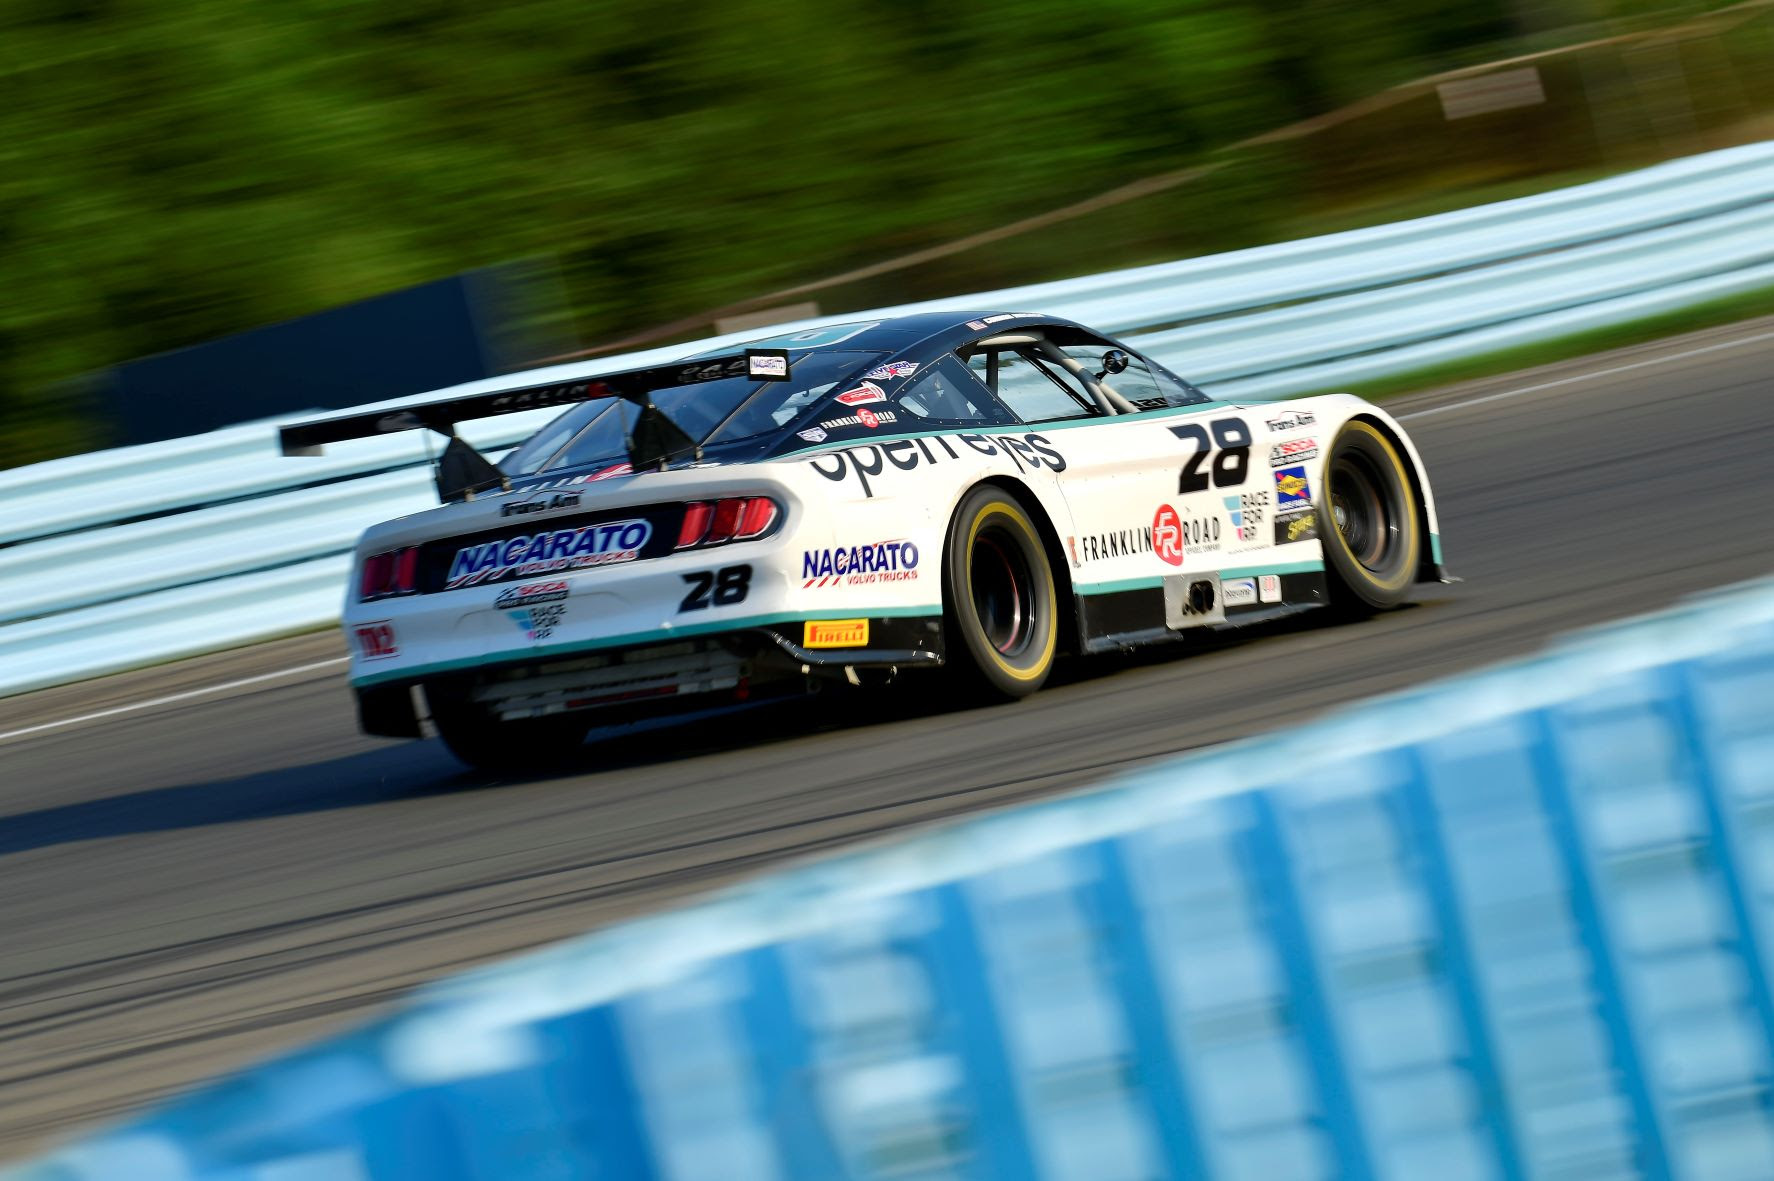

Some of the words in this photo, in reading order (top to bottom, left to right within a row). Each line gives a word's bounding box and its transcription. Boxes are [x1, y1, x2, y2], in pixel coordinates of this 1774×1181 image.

[820, 414, 861, 429] FRANKLIN
[875, 411, 896, 421] ROAD
[956, 433, 1067, 474] eyes
[1166, 417, 1252, 495] 28
[1242, 491, 1269, 506] RACE
[1242, 509, 1262, 524] FOR
[454, 521, 648, 578] NACARATO
[1082, 526, 1153, 562] FRANKLIN
[1182, 516, 1220, 546] ROAD
[518, 559, 566, 576] VOLVO
[571, 551, 639, 568] TRUCKS
[803, 542, 919, 579] NACARATO
[519, 581, 567, 596] SCCA
[677, 563, 753, 615] 28
[847, 573, 876, 586] VOLVO
[878, 570, 918, 583] TRUCKS
[531, 604, 567, 617] RACE
[809, 624, 864, 643] PIRELLI
